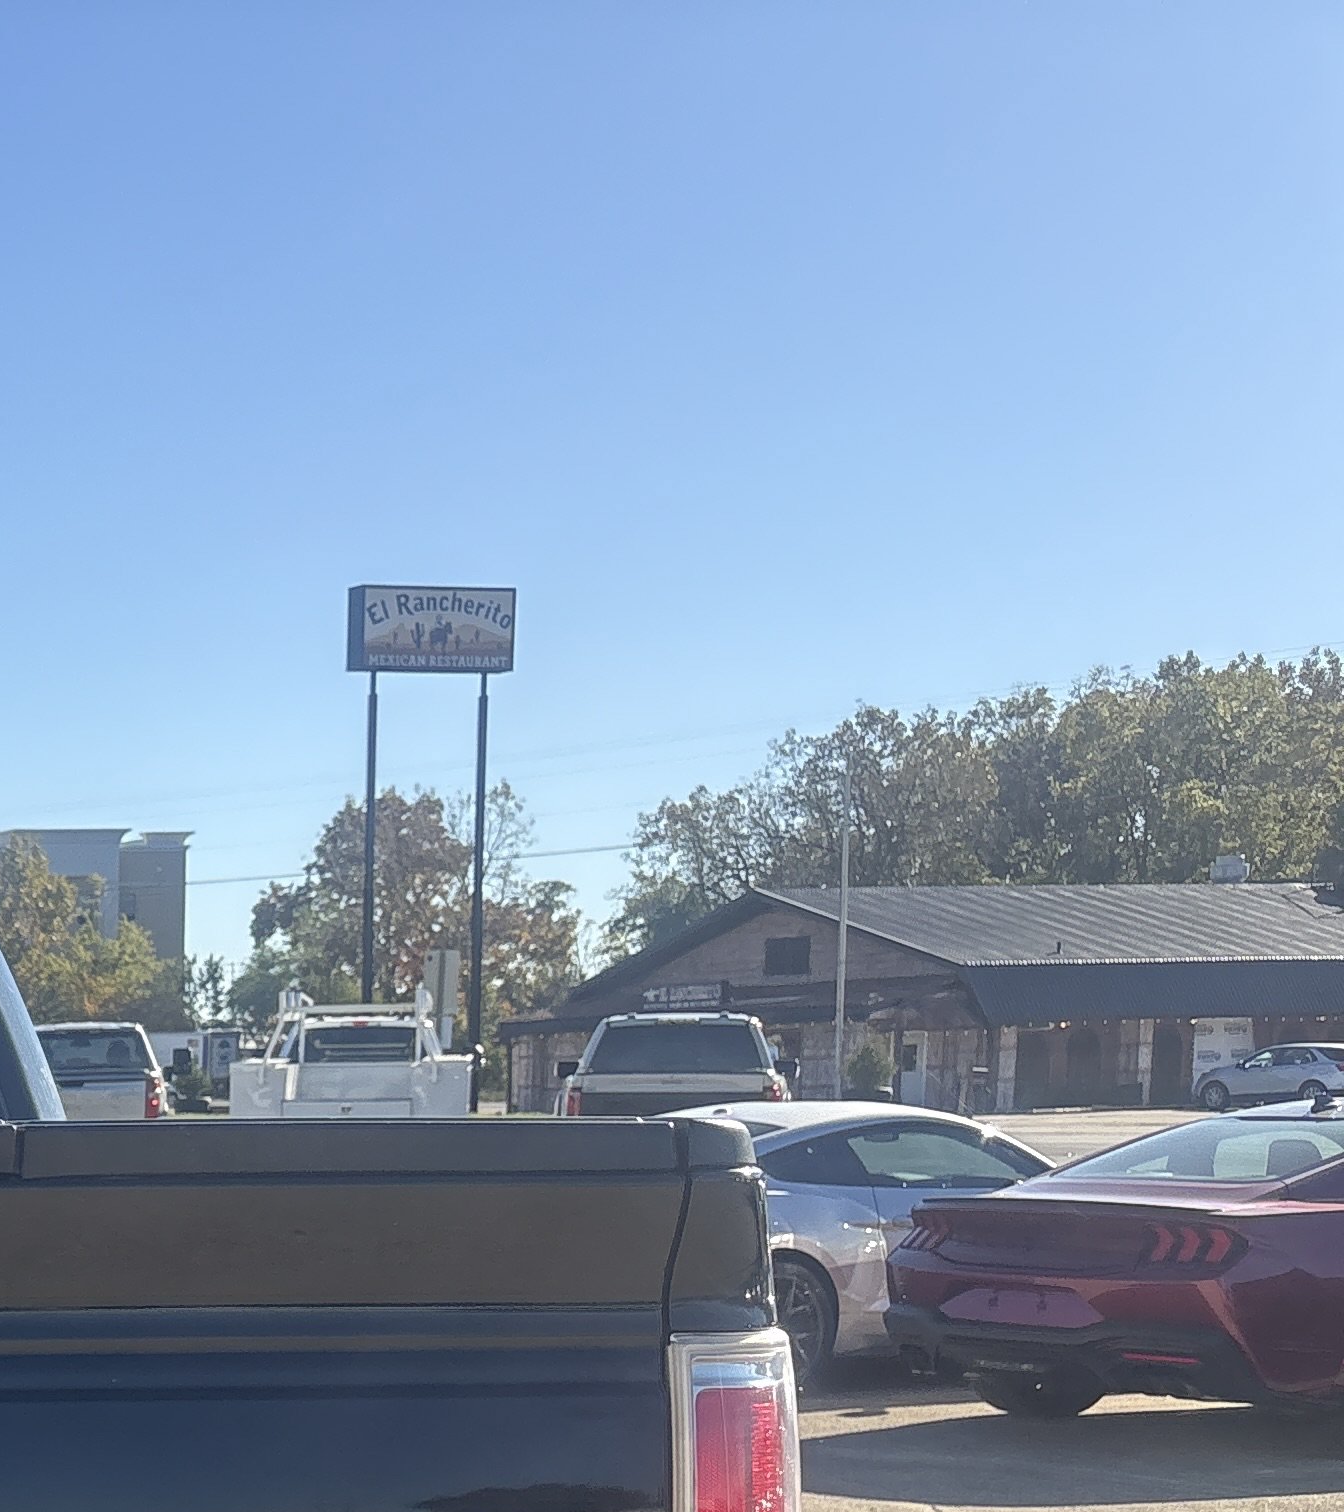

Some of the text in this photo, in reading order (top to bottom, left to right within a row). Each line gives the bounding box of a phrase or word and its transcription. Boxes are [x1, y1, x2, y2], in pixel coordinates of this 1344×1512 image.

[366, 591, 513, 630] El Rancherito
[368, 653, 509, 668] MEXICAN RESTAURANT
